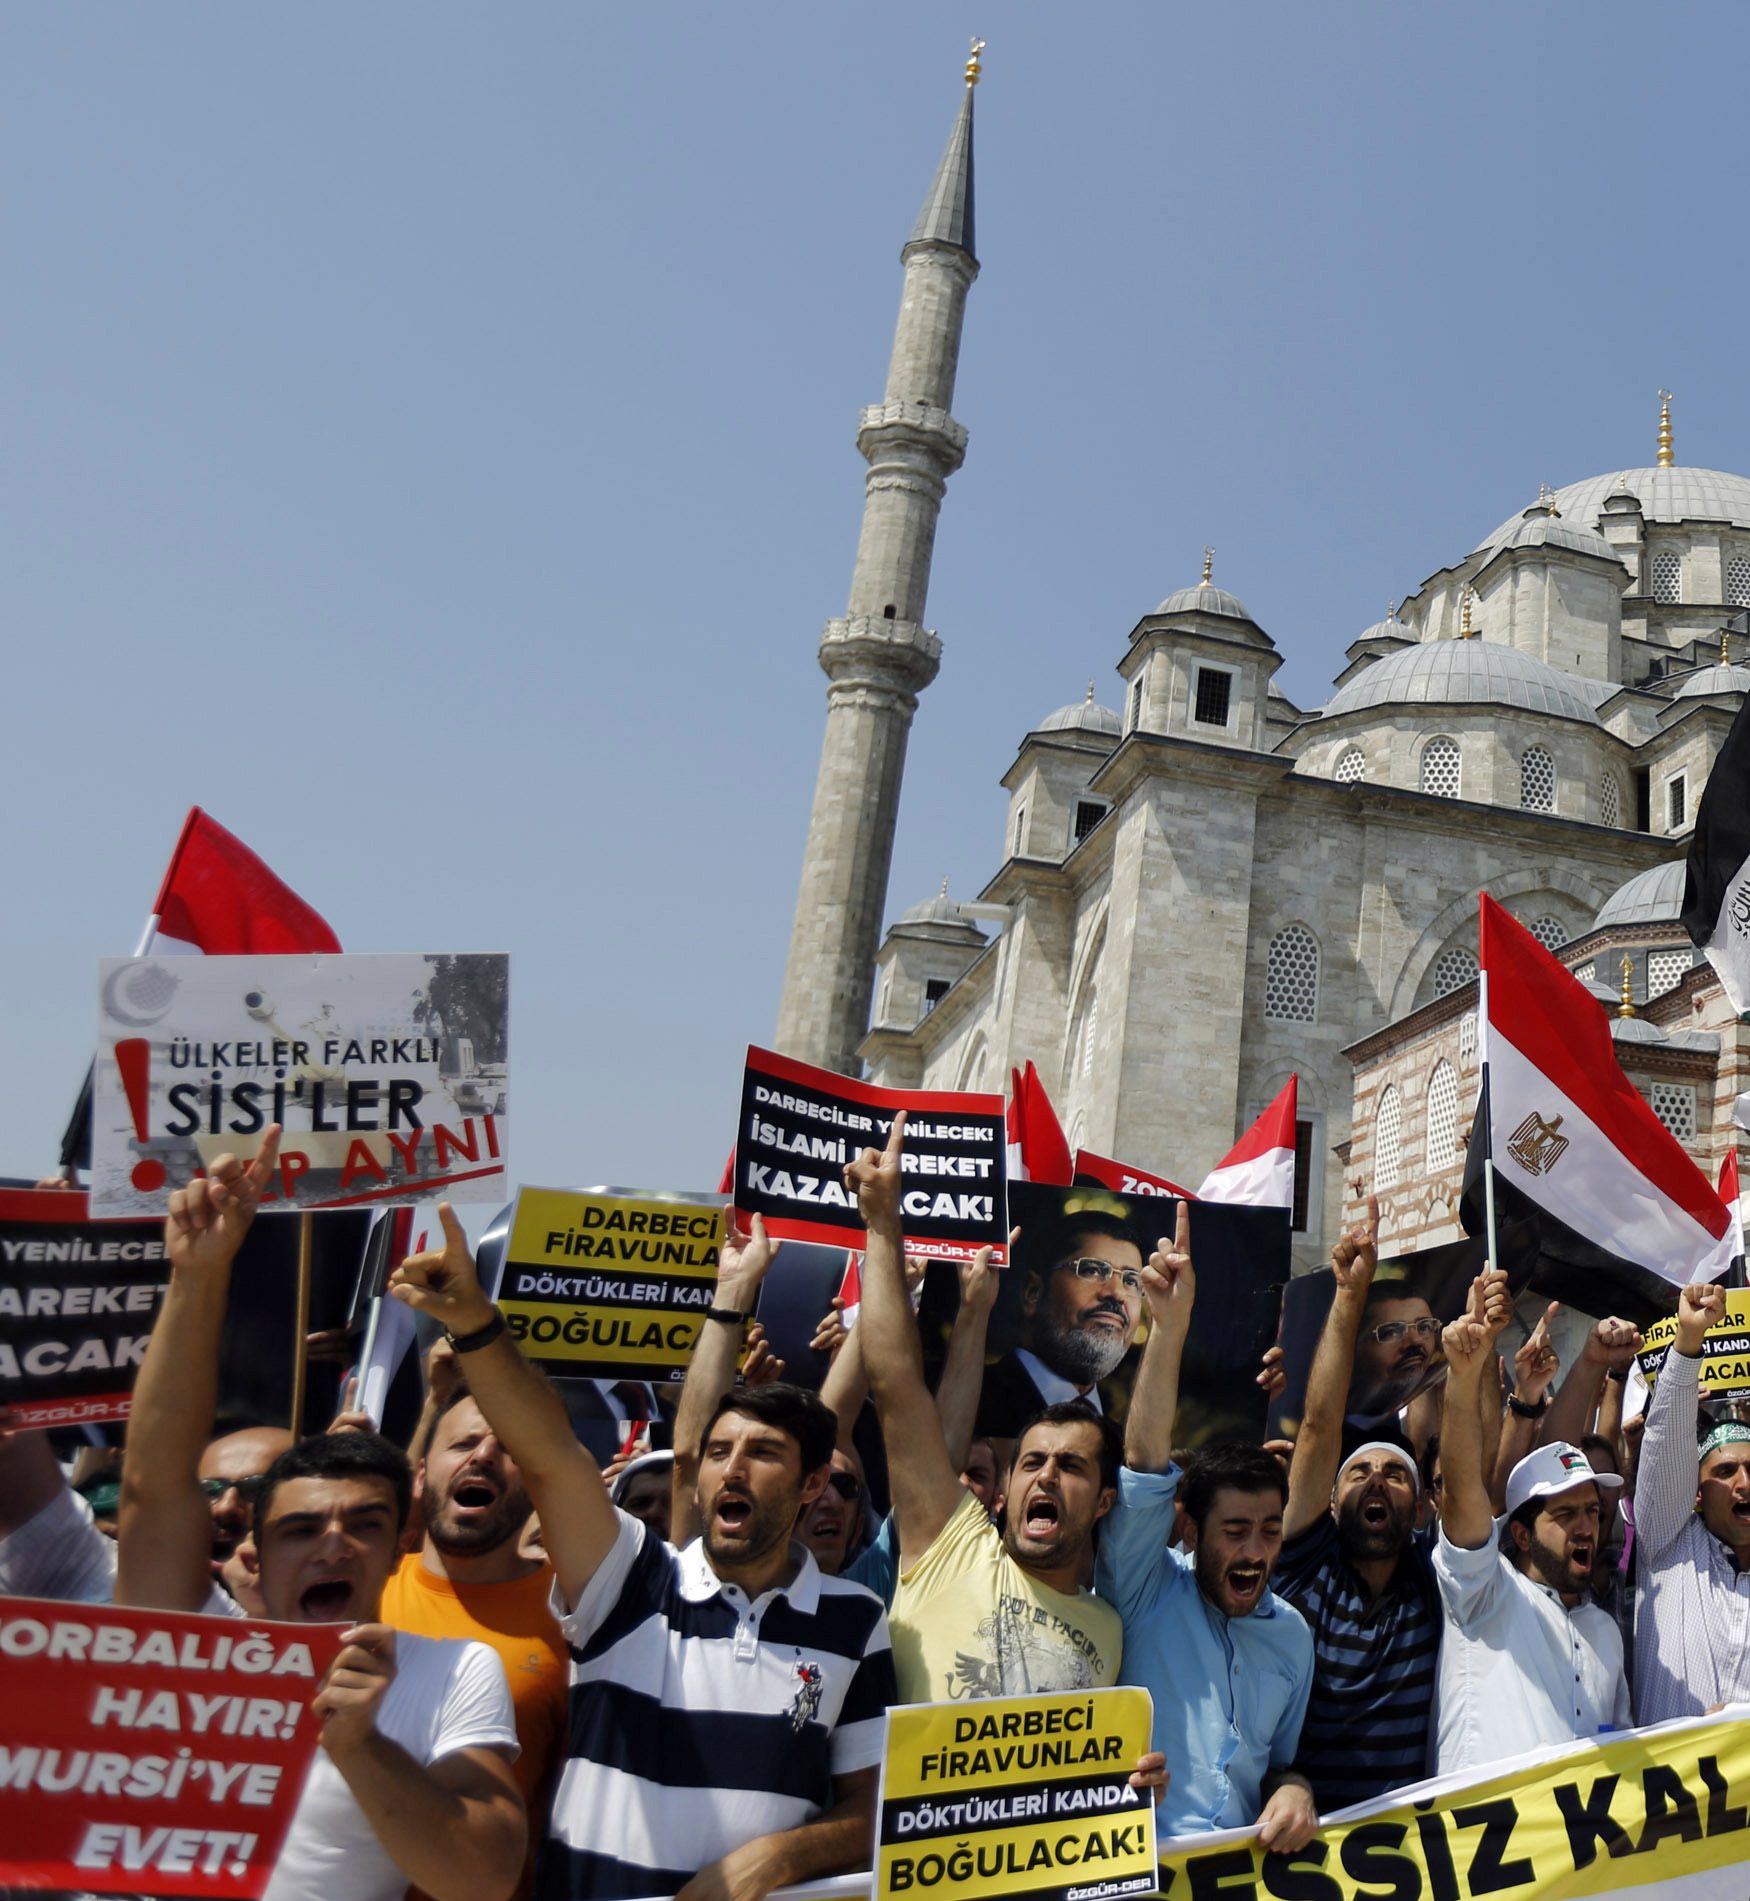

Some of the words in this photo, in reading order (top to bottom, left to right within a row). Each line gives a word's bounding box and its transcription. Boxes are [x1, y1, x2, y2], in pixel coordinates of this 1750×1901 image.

[170, 1037, 309, 1068] ÜLKELER
[324, 1038, 439, 1066] FARKLI
[165, 1068, 425, 1137] SİSİ'LER
[755, 1085, 873, 1132] DARBECİLER
[877, 1119, 994, 1142] YNİLECEK!
[340, 1114, 500, 1189] AYNI
[750, 1112, 847, 1165] İSLAMİ
[855, 1146, 994, 1178] REKET
[747, 1160, 994, 1222] KAZACAK!
[1121, 1174, 1186, 1199] ZO
[582, 1206, 719, 1240] DARBECİ
[2, 1236, 171, 1262] YENİLECE
[903, 1240, 1004, 1261] ÖZGÜR-DR
[517, 1272, 668, 1303] DÖKTÜKLERİ
[672, 1286, 716, 1306] KAN
[506, 1311, 702, 1352] BOĞULAC
[0, 1617, 316, 1677] ORBALIĞA
[90, 1686, 304, 1740] HAYIR!
[954, 1698, 1094, 1744] DARBECİ
[920, 1735, 1124, 1782] FİRAVUNLAR
[897, 1788, 1049, 1834] DÖKTÜKLERİ
[1055, 1783, 1140, 1813] KANDA
[73, 1822, 258, 1877] EVET!
[889, 1823, 1146, 1893] BOĞULACAK!
[1067, 1877, 1151, 1901] ÖZGÜR-DER
